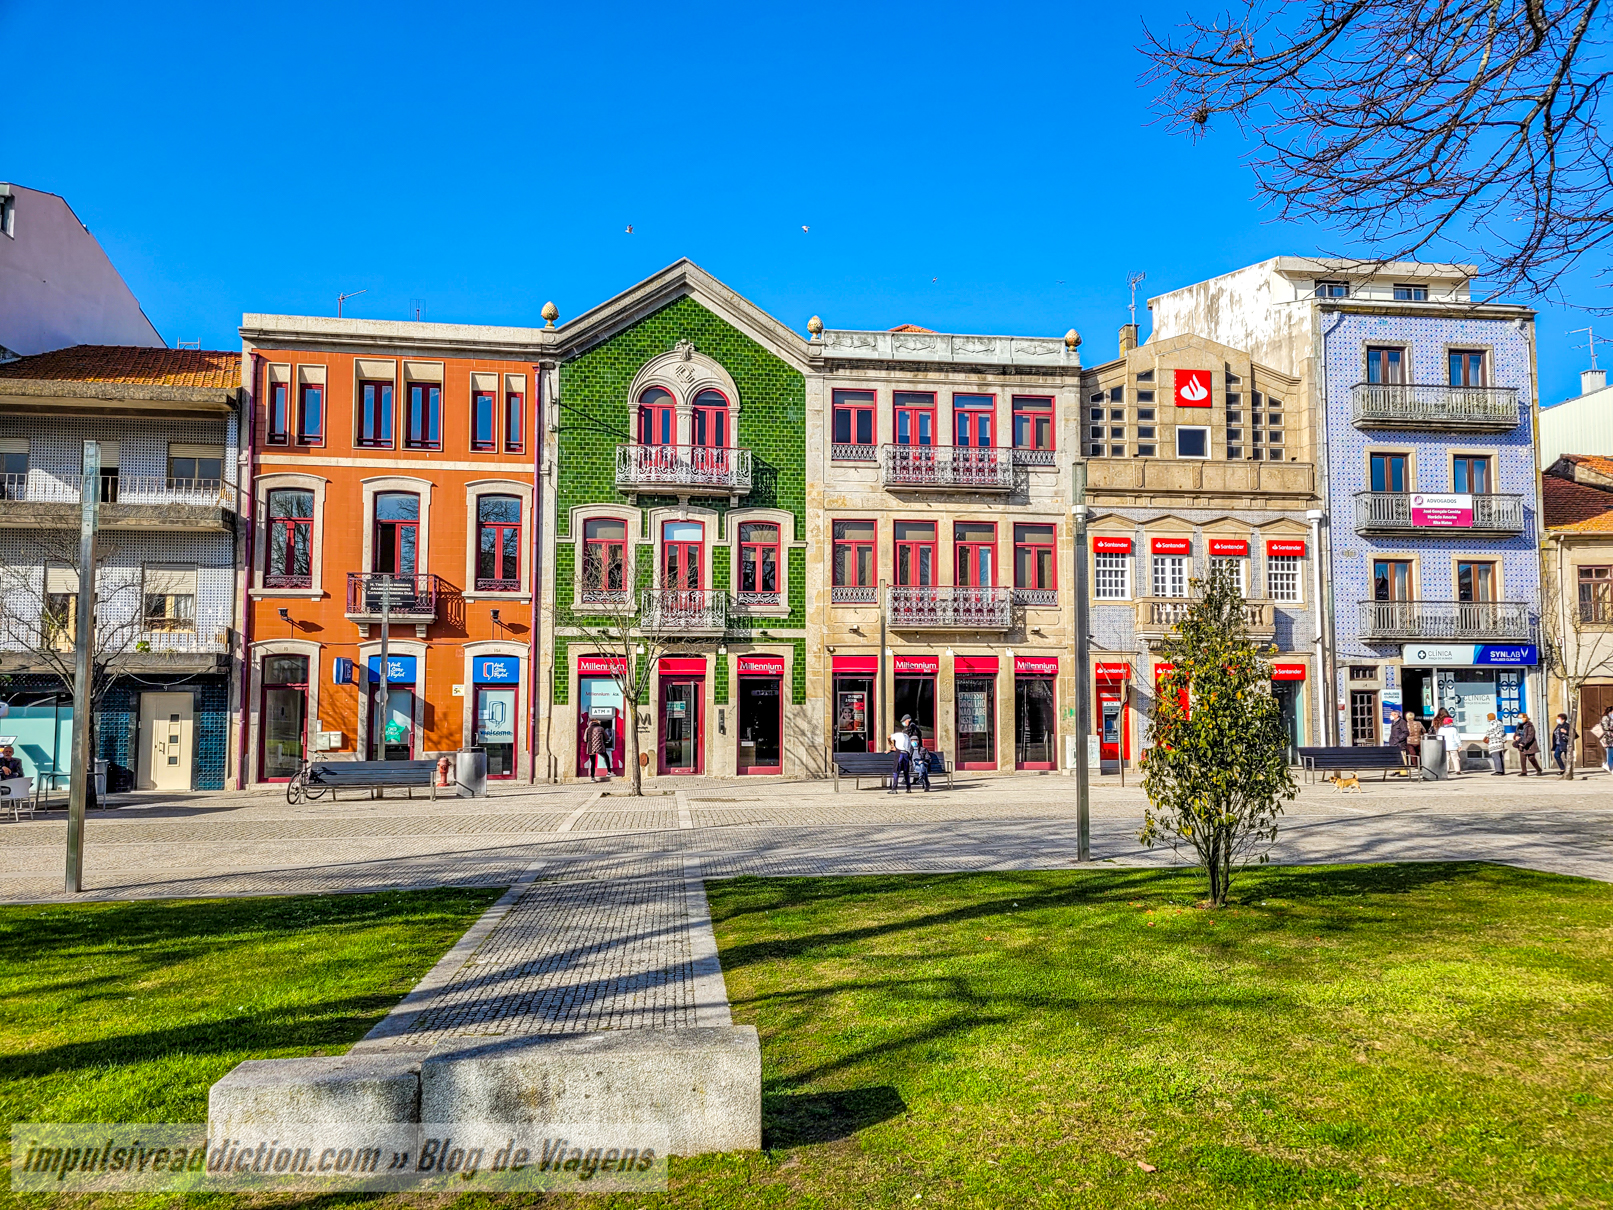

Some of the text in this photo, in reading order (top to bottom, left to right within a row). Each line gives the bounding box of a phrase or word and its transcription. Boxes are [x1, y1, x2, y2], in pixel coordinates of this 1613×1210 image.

[740, 662, 782, 670] Millennium
[896, 660, 936, 669] Millennium
[1017, 661, 1056, 669] Millennium
